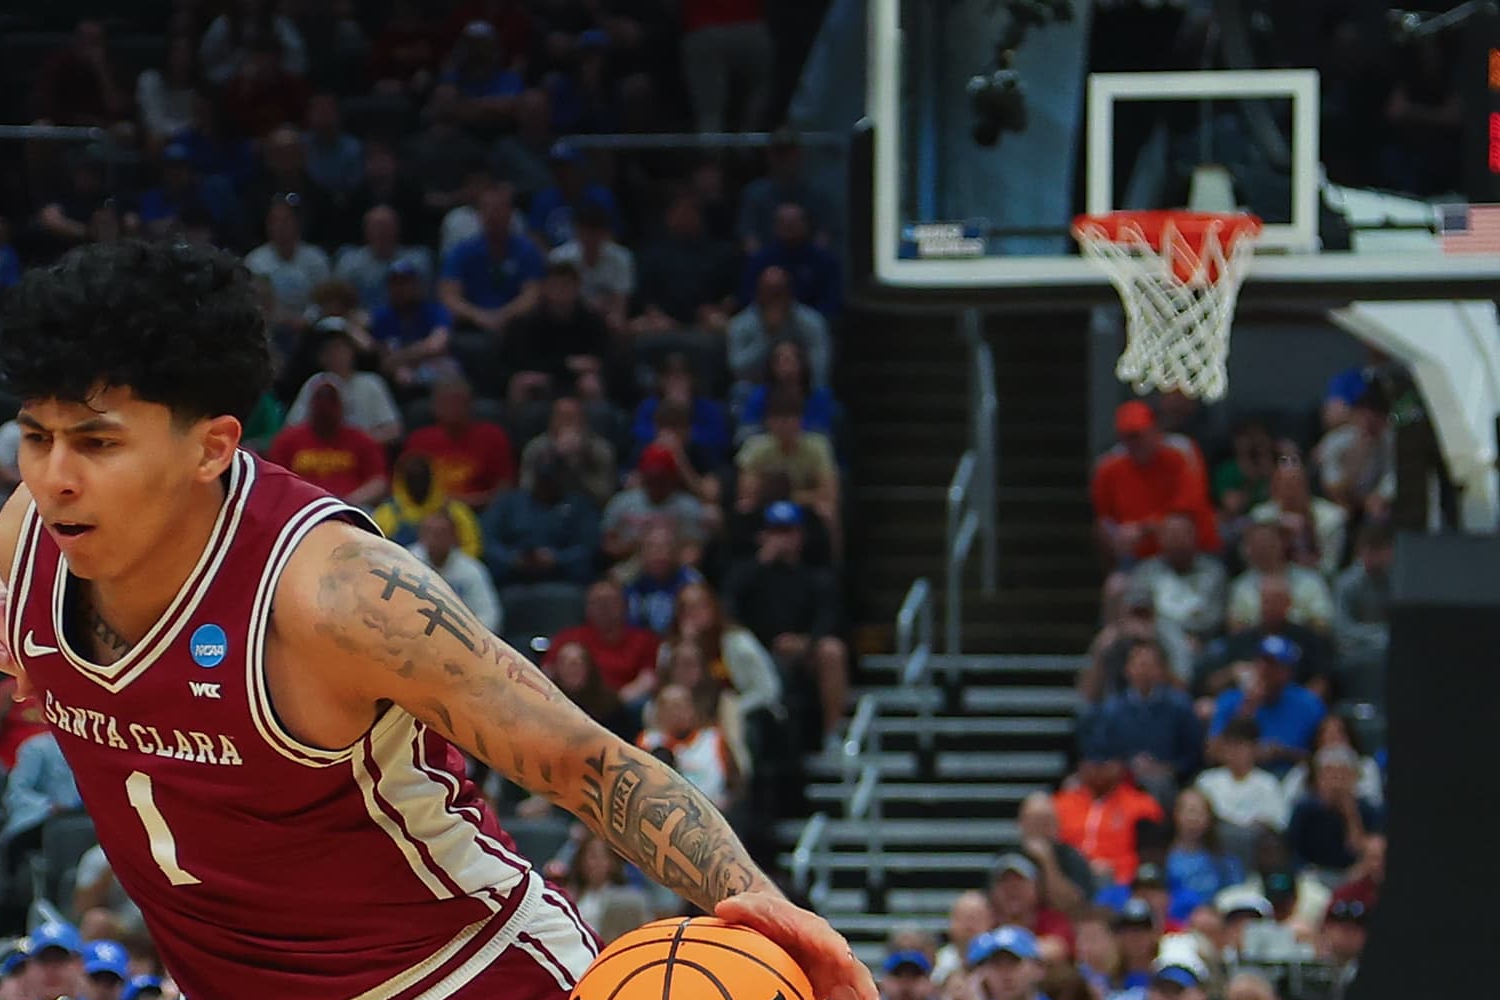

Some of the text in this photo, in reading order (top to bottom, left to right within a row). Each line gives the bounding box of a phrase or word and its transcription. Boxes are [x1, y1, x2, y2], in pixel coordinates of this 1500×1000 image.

[194, 643, 224, 657] NCAA
[188, 681, 221, 699] WCC
[44, 688, 244, 766] SANTA CLARA
[125, 770, 203, 887] 1
